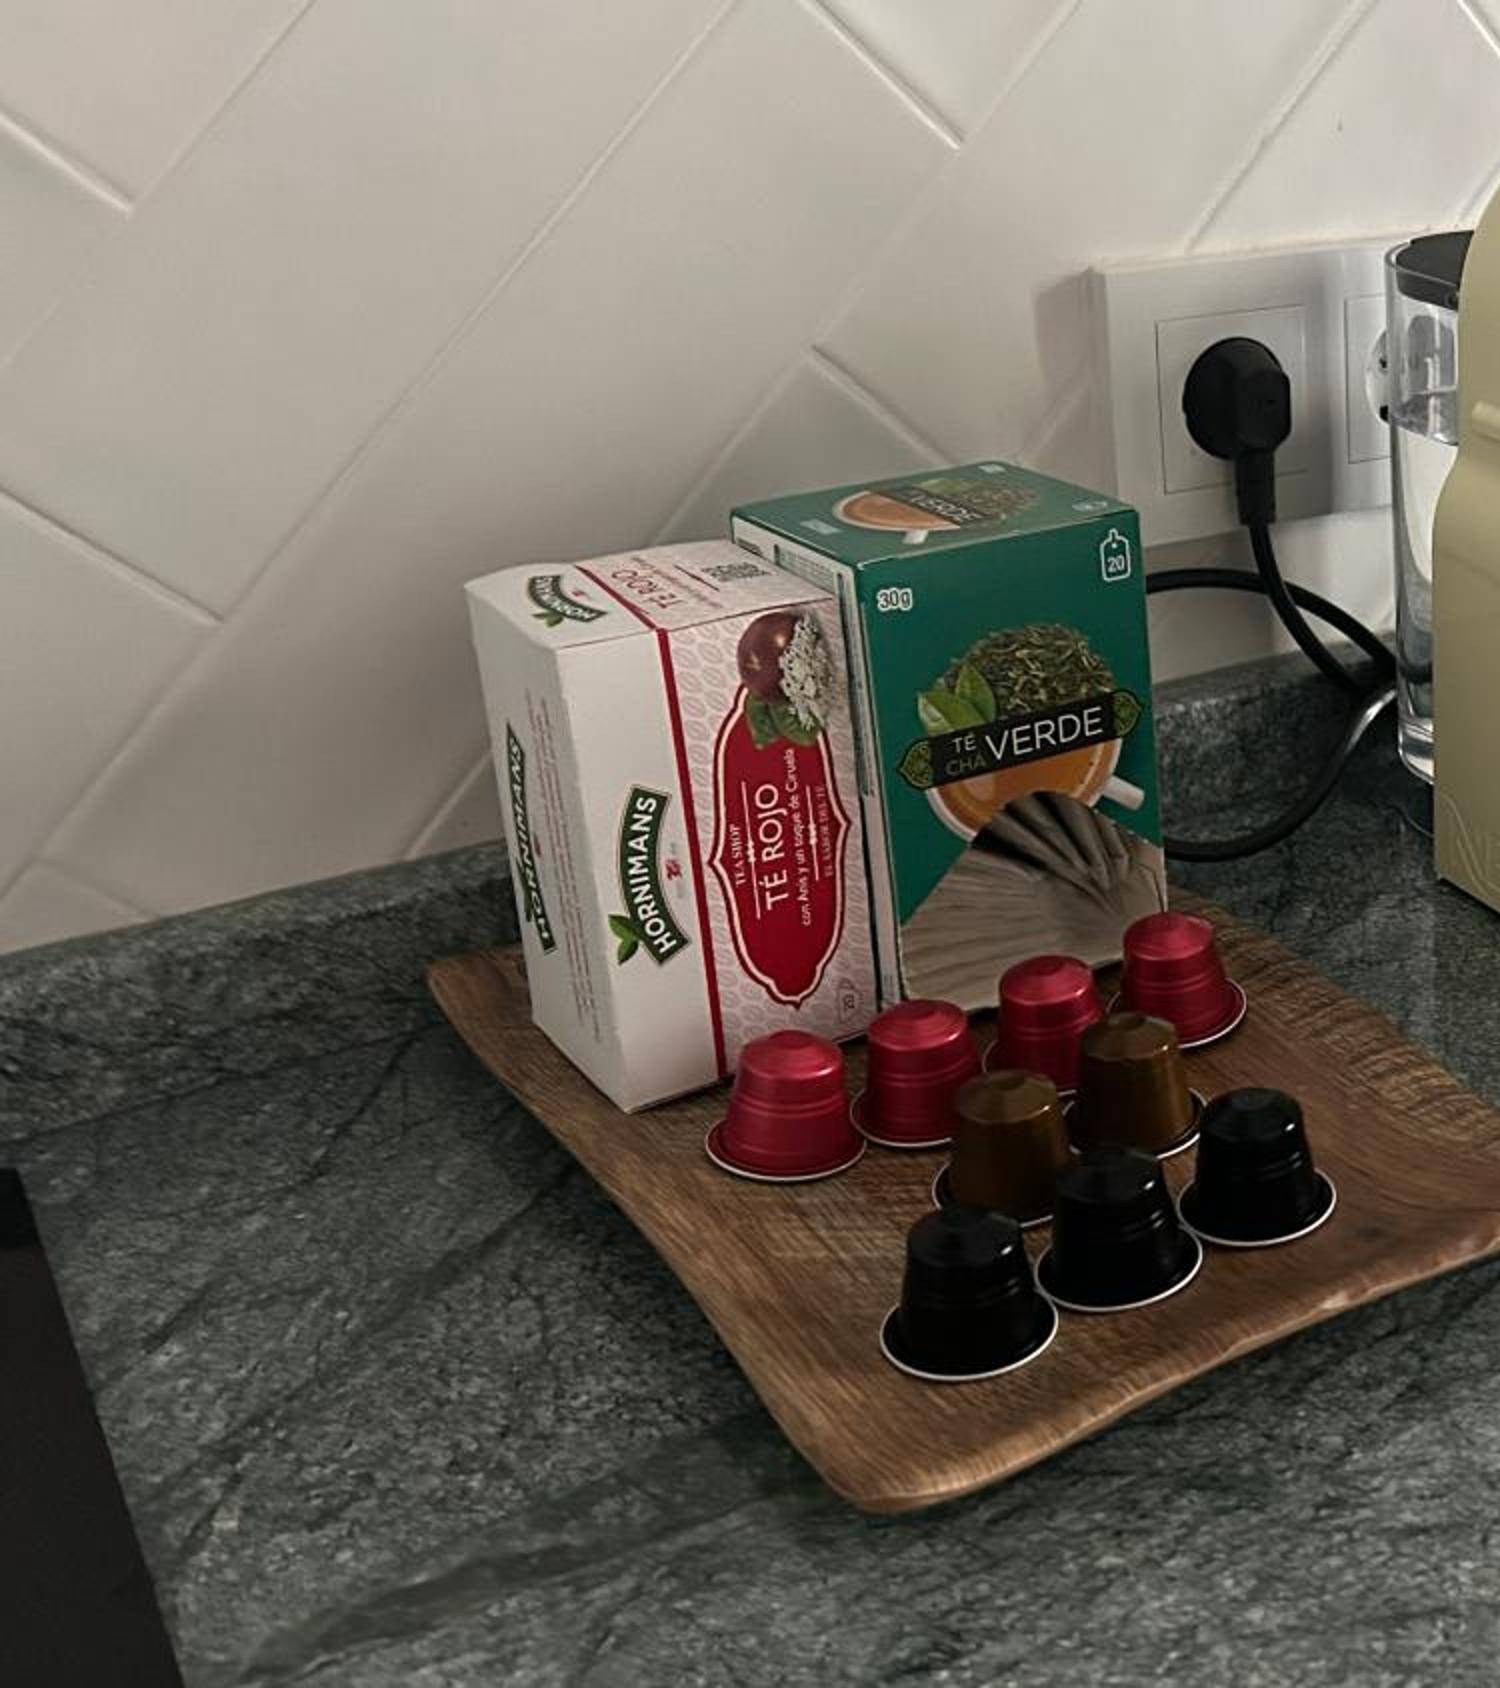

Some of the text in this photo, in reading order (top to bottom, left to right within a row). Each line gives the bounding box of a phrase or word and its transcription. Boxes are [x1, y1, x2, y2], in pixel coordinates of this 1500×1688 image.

[1107, 554, 1125, 573] 20
[985, 706, 1103, 761] VERDE
[783, 748, 798, 793] Ciruela
[787, 794, 799, 810] de
[729, 824, 746, 887] TEA SHOP
[755, 783, 789, 911] TÉ ROJO
[795, 848, 806, 865] un
[627, 796, 677, 953] HORNIMANS
